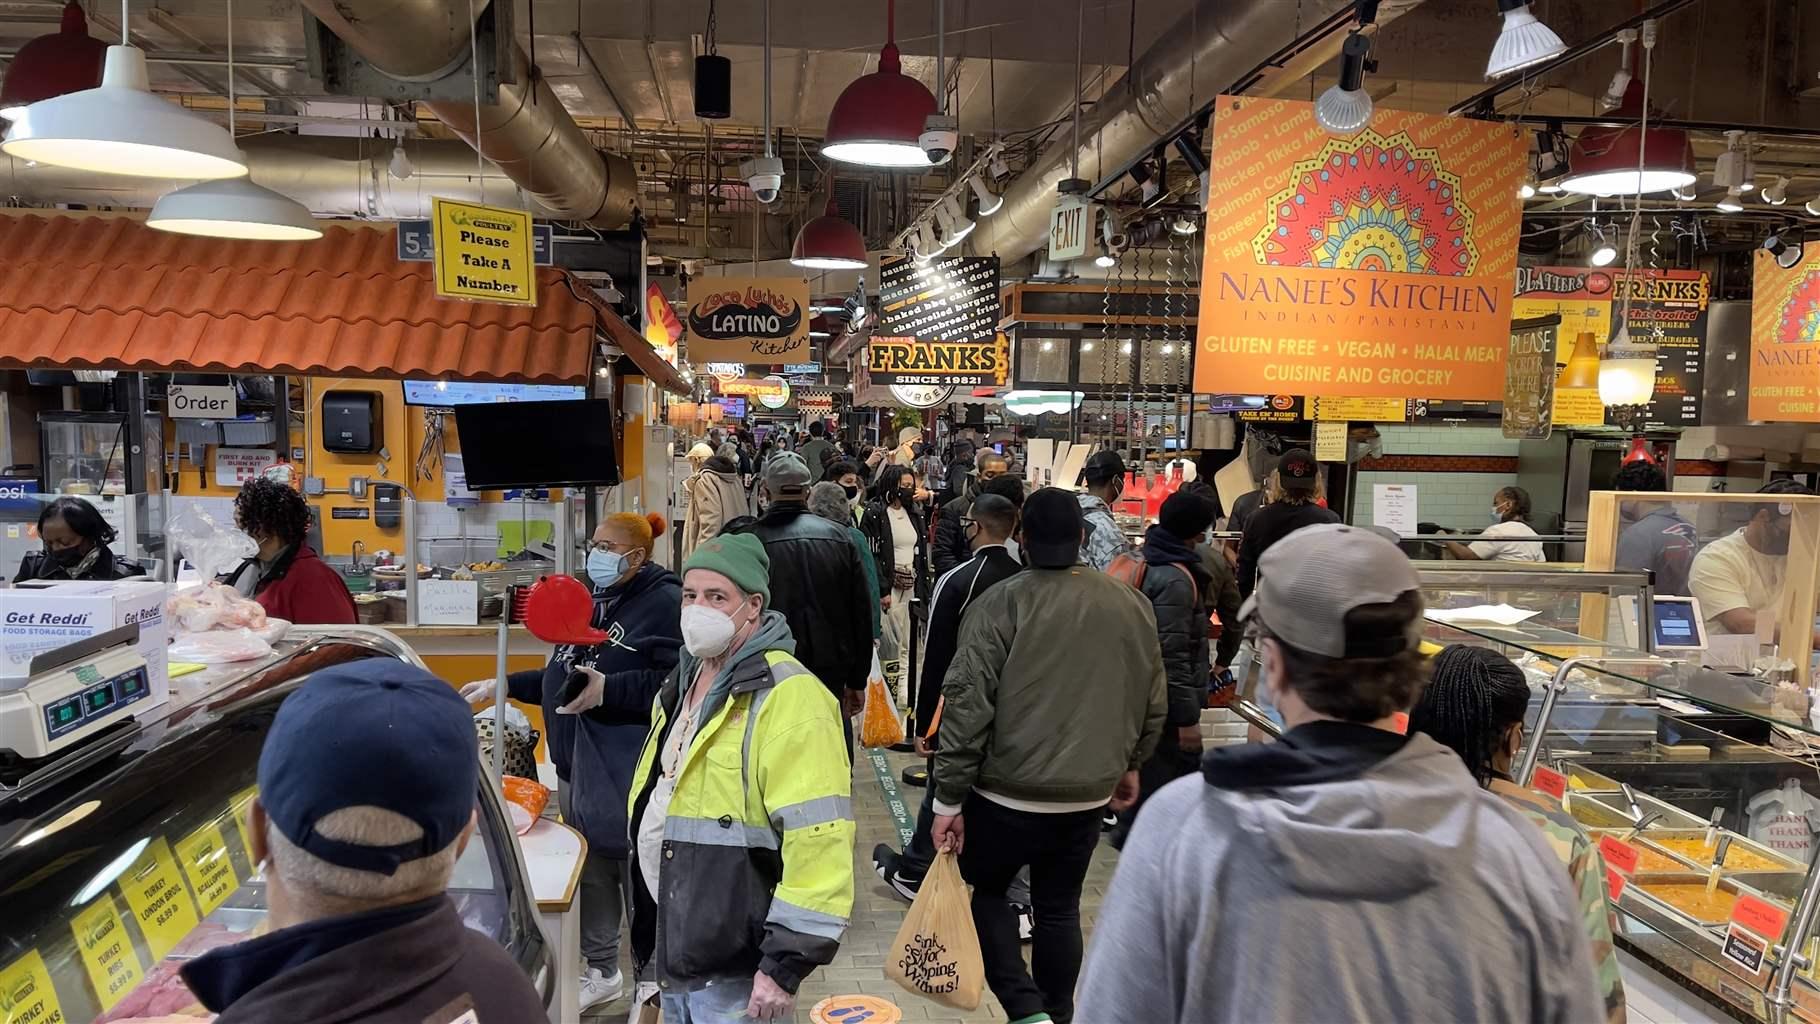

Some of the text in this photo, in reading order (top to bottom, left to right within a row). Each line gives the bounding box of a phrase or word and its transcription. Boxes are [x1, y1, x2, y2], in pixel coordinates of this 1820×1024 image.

[1229, 102, 1285, 139] Samosa
[1214, 107, 1313, 172] Kabob Lamb
[1445, 124, 1472, 149] Lassi
[1210, 162, 1265, 199] Chicken
[1265, 138, 1302, 170] Tikka
[1462, 177, 1494, 204] Lamb
[1484, 190, 1506, 211] Nan
[1210, 187, 1263, 223] Salmon
[1055, 208, 1082, 250] EXIT
[1208, 214, 1257, 247] Paneer
[1475, 209, 1510, 238] Gluten
[460, 231, 510, 249] Please
[1223, 239, 1250, 261] Fish
[461, 253, 512, 271] Take A
[936, 256, 965, 272] rings
[456, 275, 519, 294] Number
[881, 279, 932, 302] macaroni
[944, 261, 981, 280] cheese
[948, 268, 996, 290] hot dogs
[1513, 267, 1585, 298] PLATTERS
[886, 307, 922, 323] baked
[924, 296, 948, 312] bbq
[949, 281, 994, 301] chicken
[1220, 272, 1499, 315] NANEE'S KITCHEN
[711, 314, 781, 334] LATINO
[892, 307, 954, 334] charbroiled
[954, 292, 997, 313] burgers
[916, 302, 1001, 338] cornbread fries
[940, 316, 993, 341] pierogies
[1652, 326, 1665, 337] &
[750, 335, 809, 356] Kitchen
[1204, 335, 1503, 363] GLUTEN FREE VEGAN HALAL MEAT
[1510, 330, 1552, 354] PLEASE
[871, 345, 997, 371] FRANKS
[895, 375, 982, 386] SINCE 1982!
[1264, 363, 1454, 386] CUISINE AND GROCERY
[174, 395, 230, 411] Order
[1751, 386, 1806, 397] GLUTEN FREE
[1778, 402, 1816, 414] CUISINE
[5, 612, 89, 626] Get Reddi
[124, 612, 140, 625] Get
[139, 604, 162, 619] Reddi
[28, 628, 68, 636] STORAGE
[69, 629, 93, 637] BAGS
[1768, 840, 1810, 849] THANK
[144, 877, 167, 900] TURKEY
[140, 896, 166, 921] LONDON
[97, 943, 122, 966] TURKEY
[935, 974, 959, 994] us!
